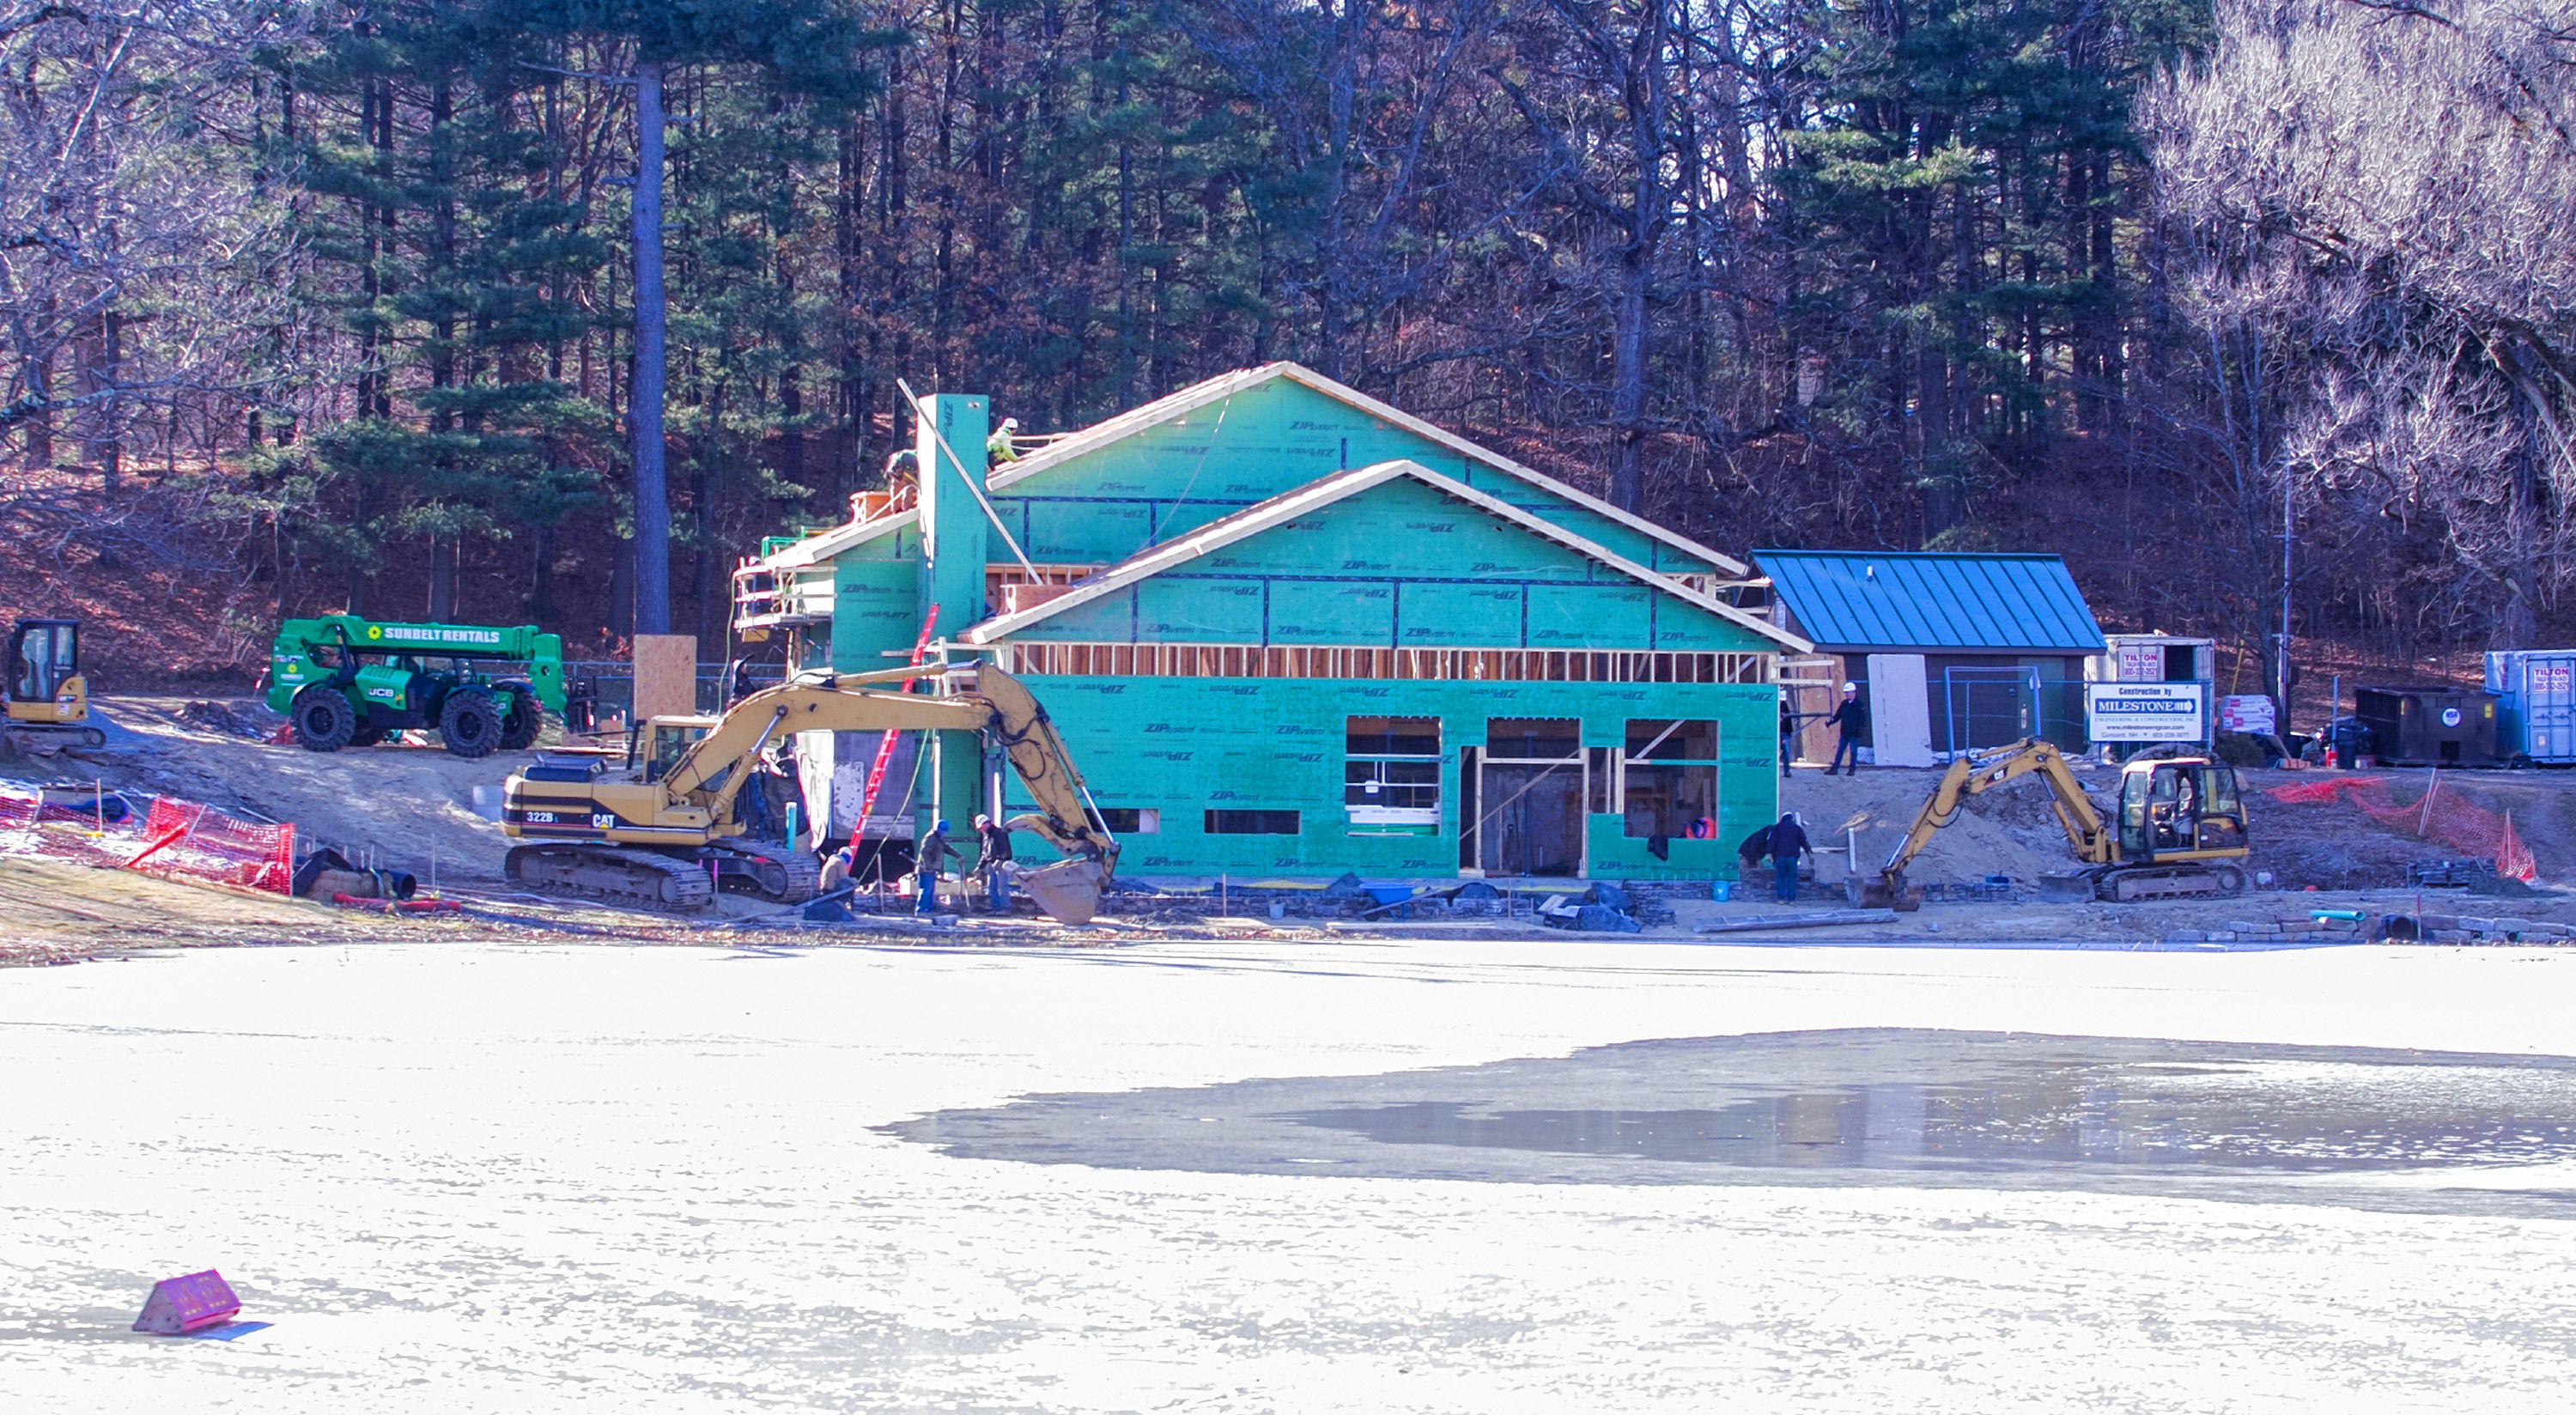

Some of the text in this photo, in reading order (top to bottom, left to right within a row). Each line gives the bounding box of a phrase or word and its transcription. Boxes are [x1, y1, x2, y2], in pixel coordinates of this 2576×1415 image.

[384, 627, 500, 643] SUNBELT RENTALS
[368, 688, 394, 697] JCB
[2118, 687, 2172, 696] Construction by
[2099, 701, 2173, 712] MILESTONE
[526, 811, 553, 823] 322B
[592, 814, 616, 829] CAT
